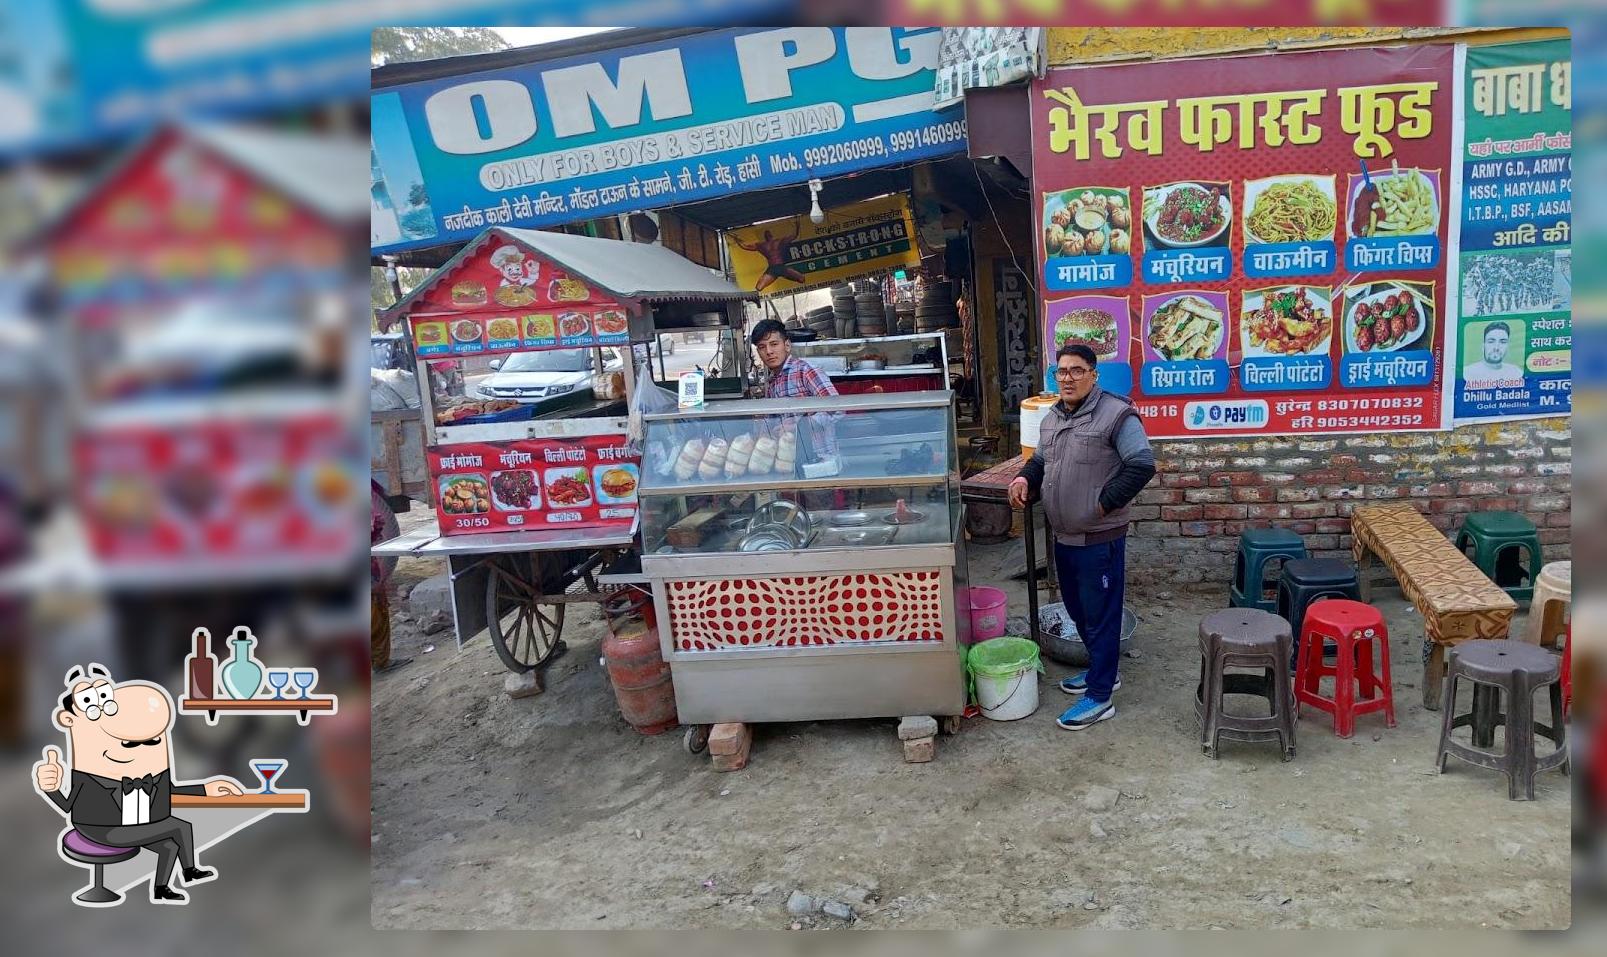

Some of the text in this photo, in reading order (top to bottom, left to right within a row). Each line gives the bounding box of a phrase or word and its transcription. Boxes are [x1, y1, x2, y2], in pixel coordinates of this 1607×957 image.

[425, 47, 693, 154] OM
[1471, 64, 1546, 117] बाबा
[1043, 81, 1439, 160] भैरव फास्ट फूड
[487, 100, 838, 189] ONLY FOR BOYS & SERVICE MAN
[1493, 140, 1512, 154] पर
[1471, 162, 1503, 179] ARMY
[1505, 161, 1530, 177] G.D.,
[1533, 157, 1566, 174] ARMY
[443, 204, 484, 231] नजदीक
[484, 198, 513, 224] काली
[513, 194, 533, 219] देवी
[568, 187, 599, 210] मॉडल
[628, 177, 641, 199] के
[770, 151, 802, 174] Mob.
[804, 137, 888, 168] 9992060999,
[1469, 184, 1501, 201] HSSC,
[1504, 180, 1557, 198] HARYANA
[1511, 202, 1534, 219] BSF,
[1493, 221, 1569, 247] आदि की
[808, 245, 893, 271] CEMENT
[1253, 246, 1328, 271] चाऊमीन
[1353, 242, 1433, 267] फिंगर चिप्स
[1057, 259, 1116, 283] मामोज
[1151, 252, 1225, 282] मंचूरियन
[1531, 317, 1565, 331] स्पेशल
[1531, 336, 1553, 348] साथ
[1188, 366, 1215, 386] रोल
[1245, 361, 1324, 385] चिल्ली पोटेटो
[1349, 358, 1428, 386] ड्राई मंचूरियन
[1465, 377, 1526, 390] Athletic Coach
[1275, 397, 1424, 416] सुरेन्द्र 8307070832
[1463, 389, 1531, 402] Dhillu Badala
[1476, 402, 1497, 410] Gold
[1539, 395, 1560, 406] M.
[1291, 414, 1423, 430] हरि 9053442352
[456, 517, 490, 528] 30/50
